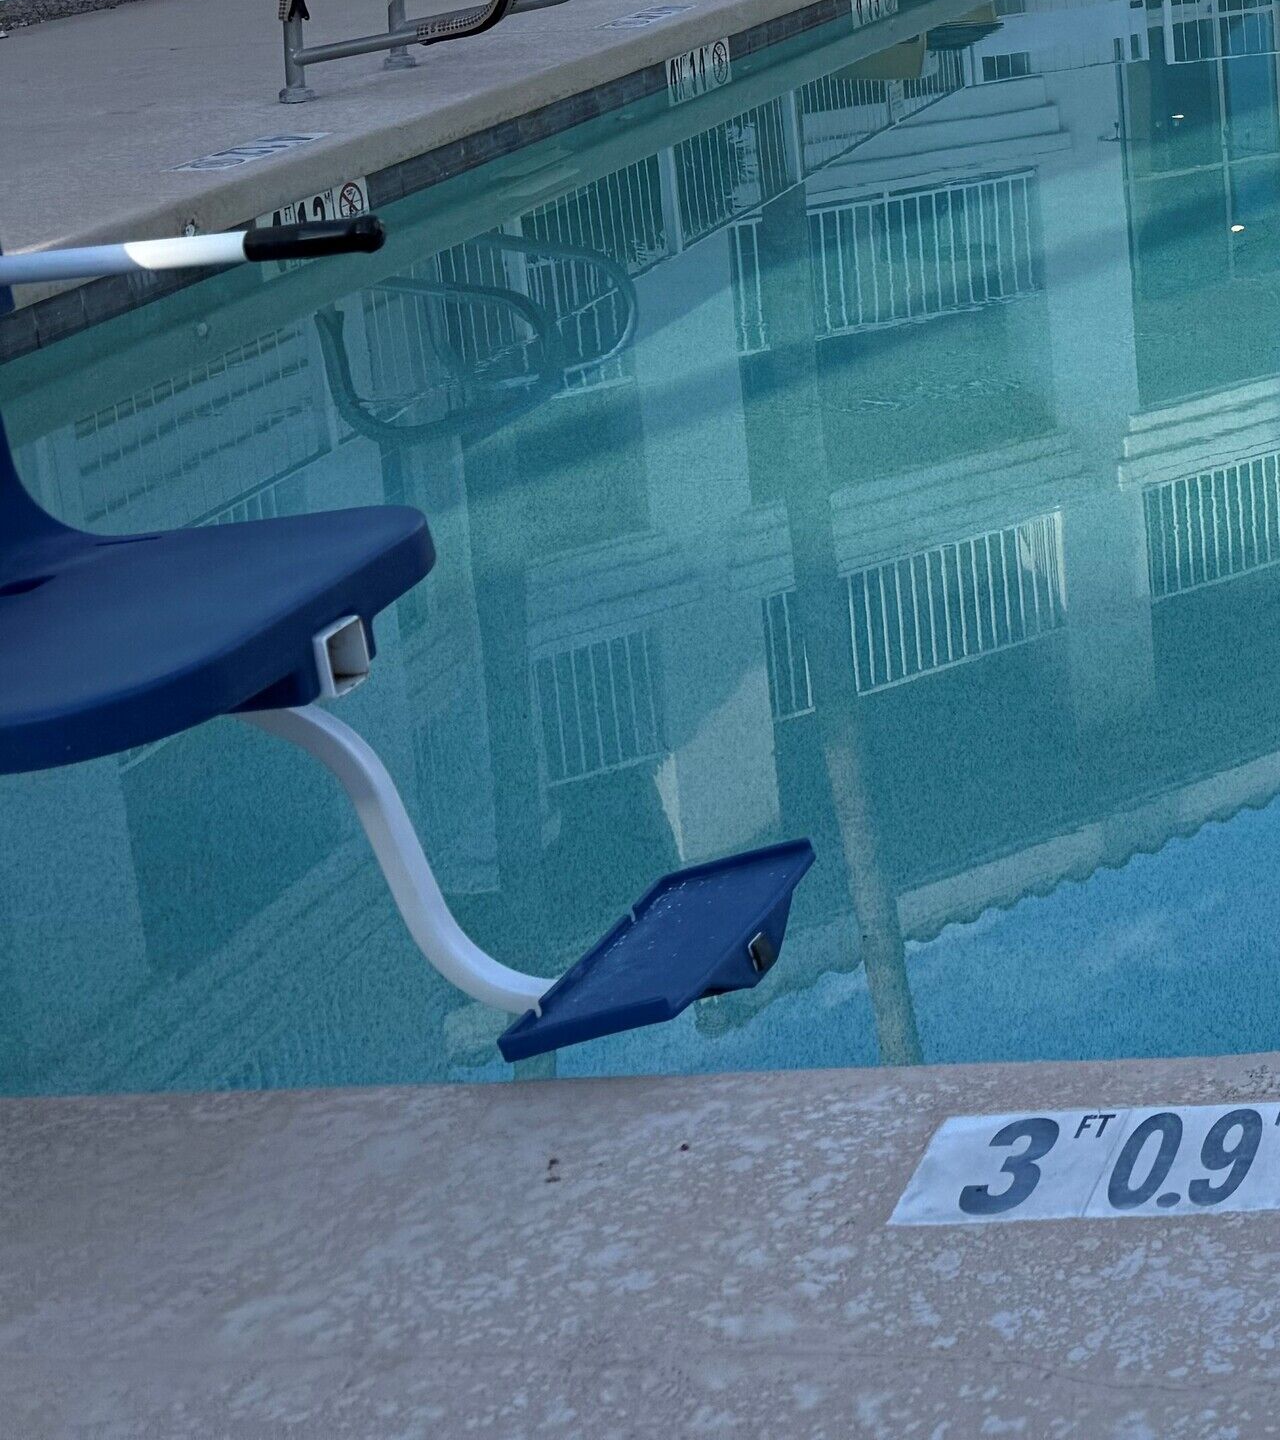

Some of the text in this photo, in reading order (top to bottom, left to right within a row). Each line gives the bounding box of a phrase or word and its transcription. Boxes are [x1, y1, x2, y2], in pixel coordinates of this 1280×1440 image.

[957, 1117, 1060, 1215] 3
[1073, 1113, 1116, 1140] FT
[1107, 1108, 1263, 1210] 0.9
